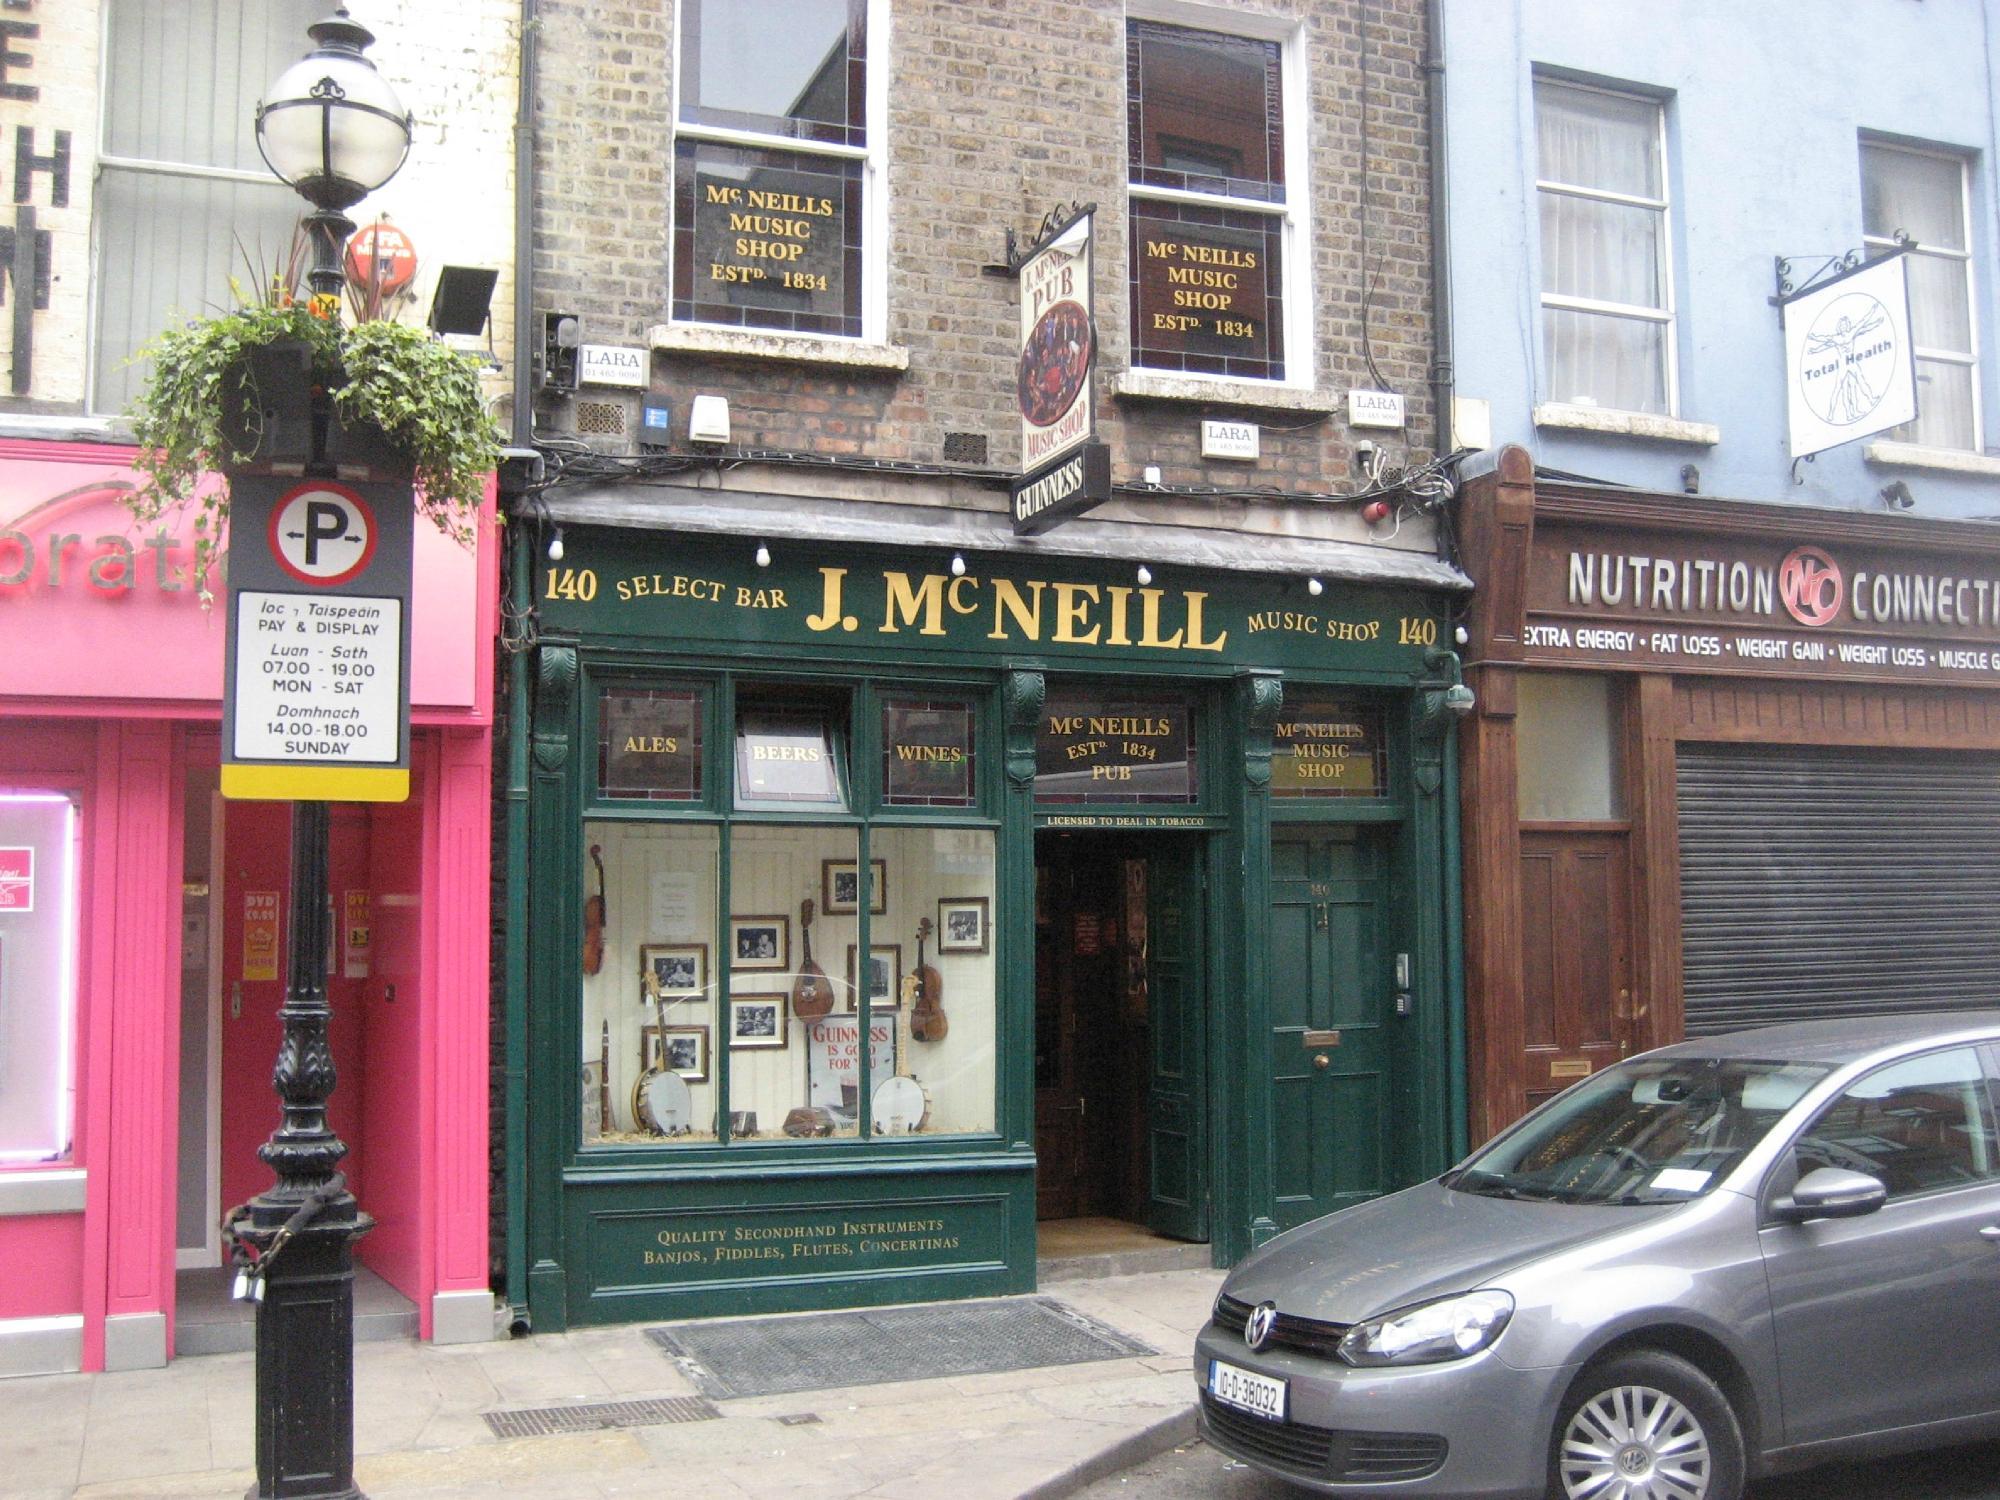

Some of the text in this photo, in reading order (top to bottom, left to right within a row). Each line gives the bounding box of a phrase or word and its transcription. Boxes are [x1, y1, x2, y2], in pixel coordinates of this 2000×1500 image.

[729, 212, 811, 238] MUSIC
[363, 230, 404, 247] AFA
[736, 238, 803, 261] SHOP
[783, 271, 828, 291] 1834
[1168, 266, 1238, 289] MUSIC
[1033, 265, 1073, 320] PUB
[1174, 289, 1232, 310] SHOP
[1216, 320, 1254, 338] 1834
[585, 350, 640, 368] LARA
[1804, 339, 1892, 381] Total Health
[1357, 395, 1398, 411] LARA
[1027, 400, 1086, 463] MUSIC SHOP
[1208, 426, 1251, 442] LARA
[1016, 455, 1083, 522] GUINNESS
[305, 501, 349, 565] P
[1569, 552, 1773, 615] NUTRITION
[308, 602, 380, 620] Taispeáin
[544, 568, 597, 601] 140
[616, 574, 726, 601] SELECT
[735, 586, 789, 609] BAR
[805, 567, 858, 632] J.
[1247, 611, 1318, 634] MUSIC
[1326, 619, 1380, 641] SHOP
[1398, 617, 1436, 646] 140
[258, 619, 379, 636] PAY & DISPLAY
[270, 643, 309, 657] Luan
[330, 645, 368, 659] Sath
[1575, 629, 1635, 651] ENERGY
[1652, 633, 1678, 653] FAT
[1682, 635, 1721, 656] LOSS
[1735, 638, 1788, 659] WEIGHT
[1792, 641, 1824, 661] GAIN
[1838, 643, 1887, 664] WEIGHT
[1892, 648, 1925, 667] LOSS
[1939, 650, 1988, 670] MUSCLE
[262, 661, 310, 675] 07.00
[331, 663, 375, 677] 19.00
[272, 679, 312, 693] MON
[333, 681, 364, 694] SAT
[276, 704, 360, 719] Domhnach
[285, 741, 350, 754] SUNDAY
[623, 736, 677, 752] ALES
[752, 745, 819, 761] BEERS
[896, 744, 961, 761] WINES
[1121, 740, 1157, 761] 1834
[1293, 743, 1350, 759] MUSIC
[1091, 765, 1132, 781] PUB
[1297, 763, 1345, 778] SHOP
[1047, 816, 1204, 827] LICENSED TO DEAL IN TOBACCO
[813, 1023, 888, 1043] GUINNSS
[828, 1044, 838, 1056] IS
[829, 1058, 850, 1070] FOR
[657, 1219, 944, 1246] QUALITY SECONDHAND INSTRUMENTS
[859, 1236, 959, 1254] CONCERTINAS
[1219, 1370, 1277, 1412] 10-D-38032
